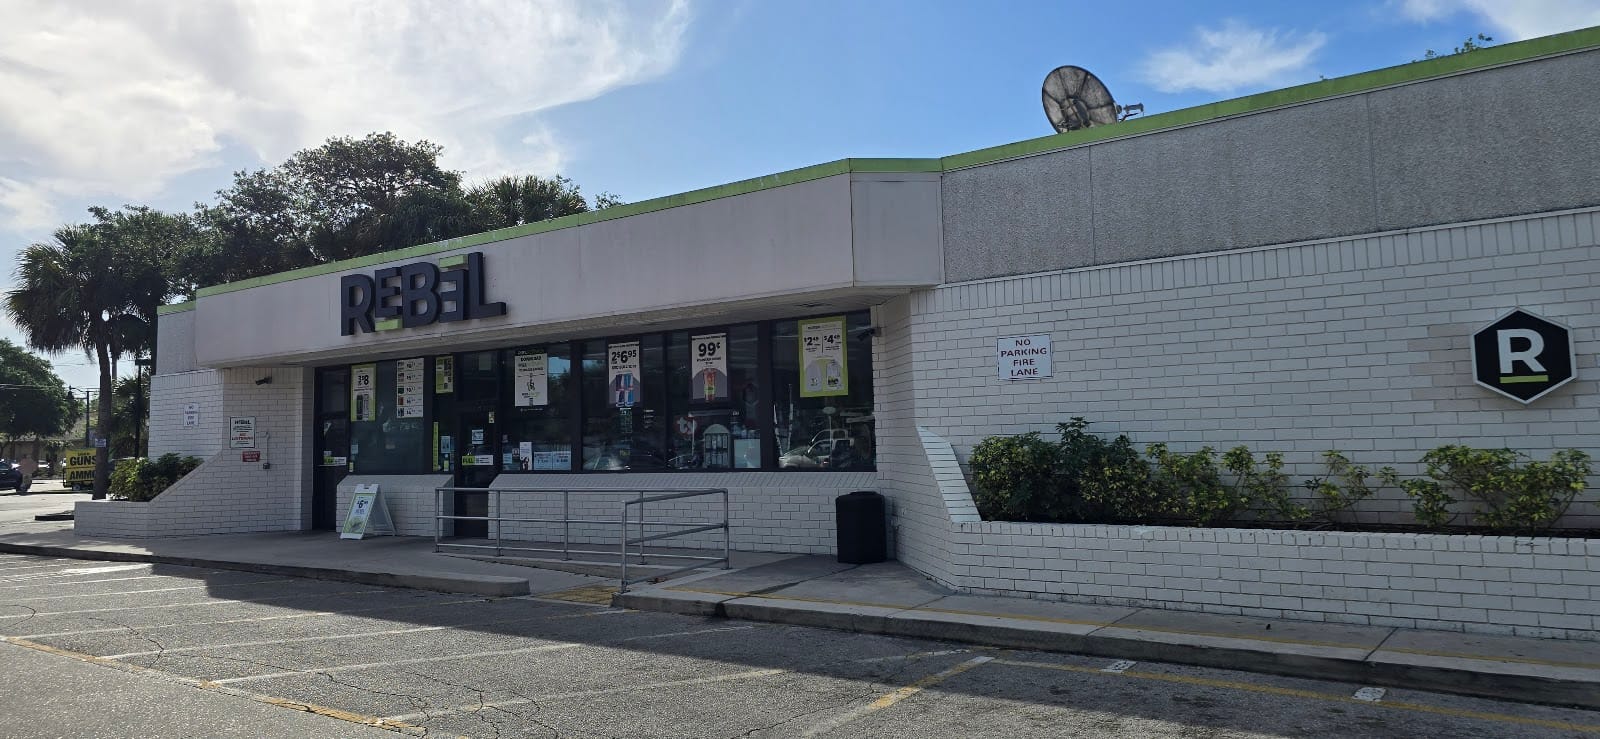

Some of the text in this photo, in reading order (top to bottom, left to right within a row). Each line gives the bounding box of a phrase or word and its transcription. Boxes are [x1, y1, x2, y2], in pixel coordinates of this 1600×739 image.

[341, 252, 507, 336] REBEL
[1001, 347, 1047, 357] PARKING
[1497, 328, 1547, 374] R
[1013, 359, 1035, 367] FIRE
[1011, 368, 1039, 377] LANE
